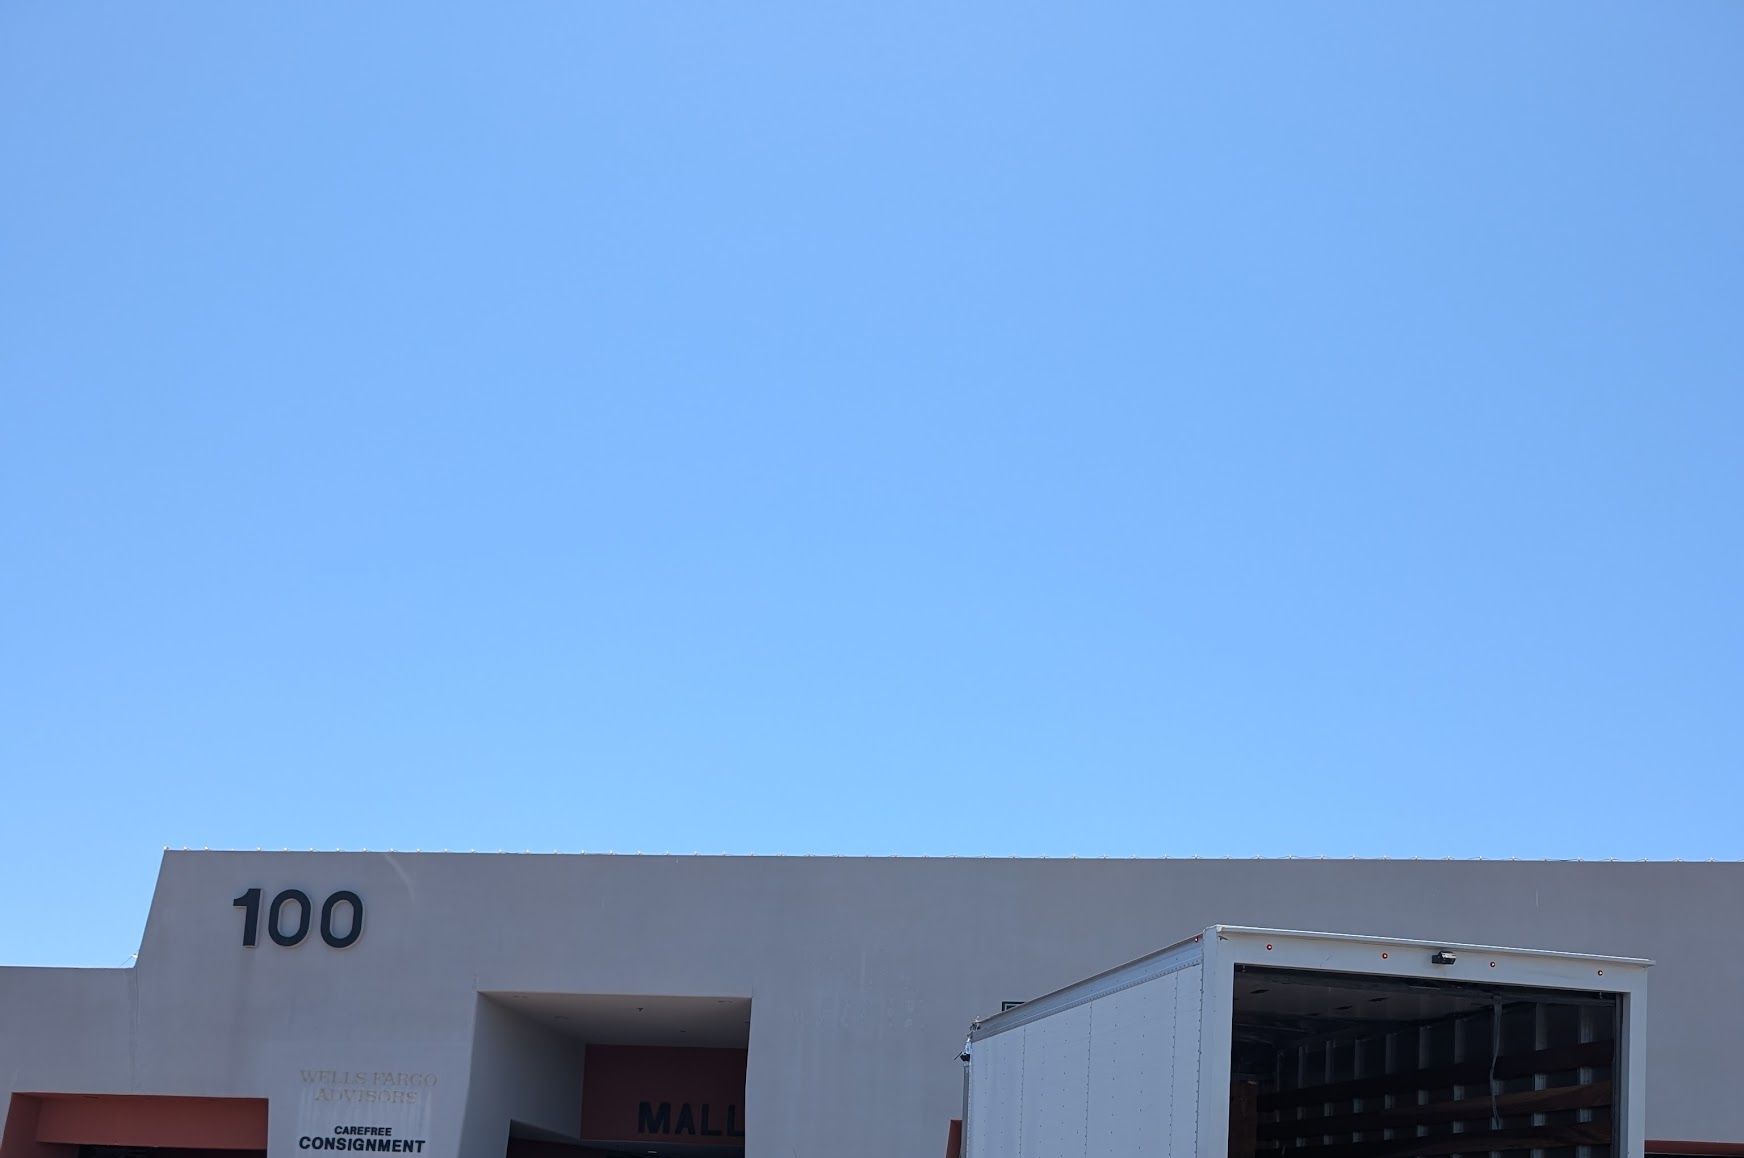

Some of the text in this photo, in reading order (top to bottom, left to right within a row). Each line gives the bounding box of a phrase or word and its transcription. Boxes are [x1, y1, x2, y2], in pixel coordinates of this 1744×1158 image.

[233, 888, 363, 948] 100
[300, 1070, 438, 1087] WELLS FARGO
[314, 1088, 417, 1104] ADVISORS
[638, 1102, 745, 1136] MALL
[334, 1126, 392, 1136] CAREFREE
[299, 1136, 425, 1153] CONSIGNMENT
